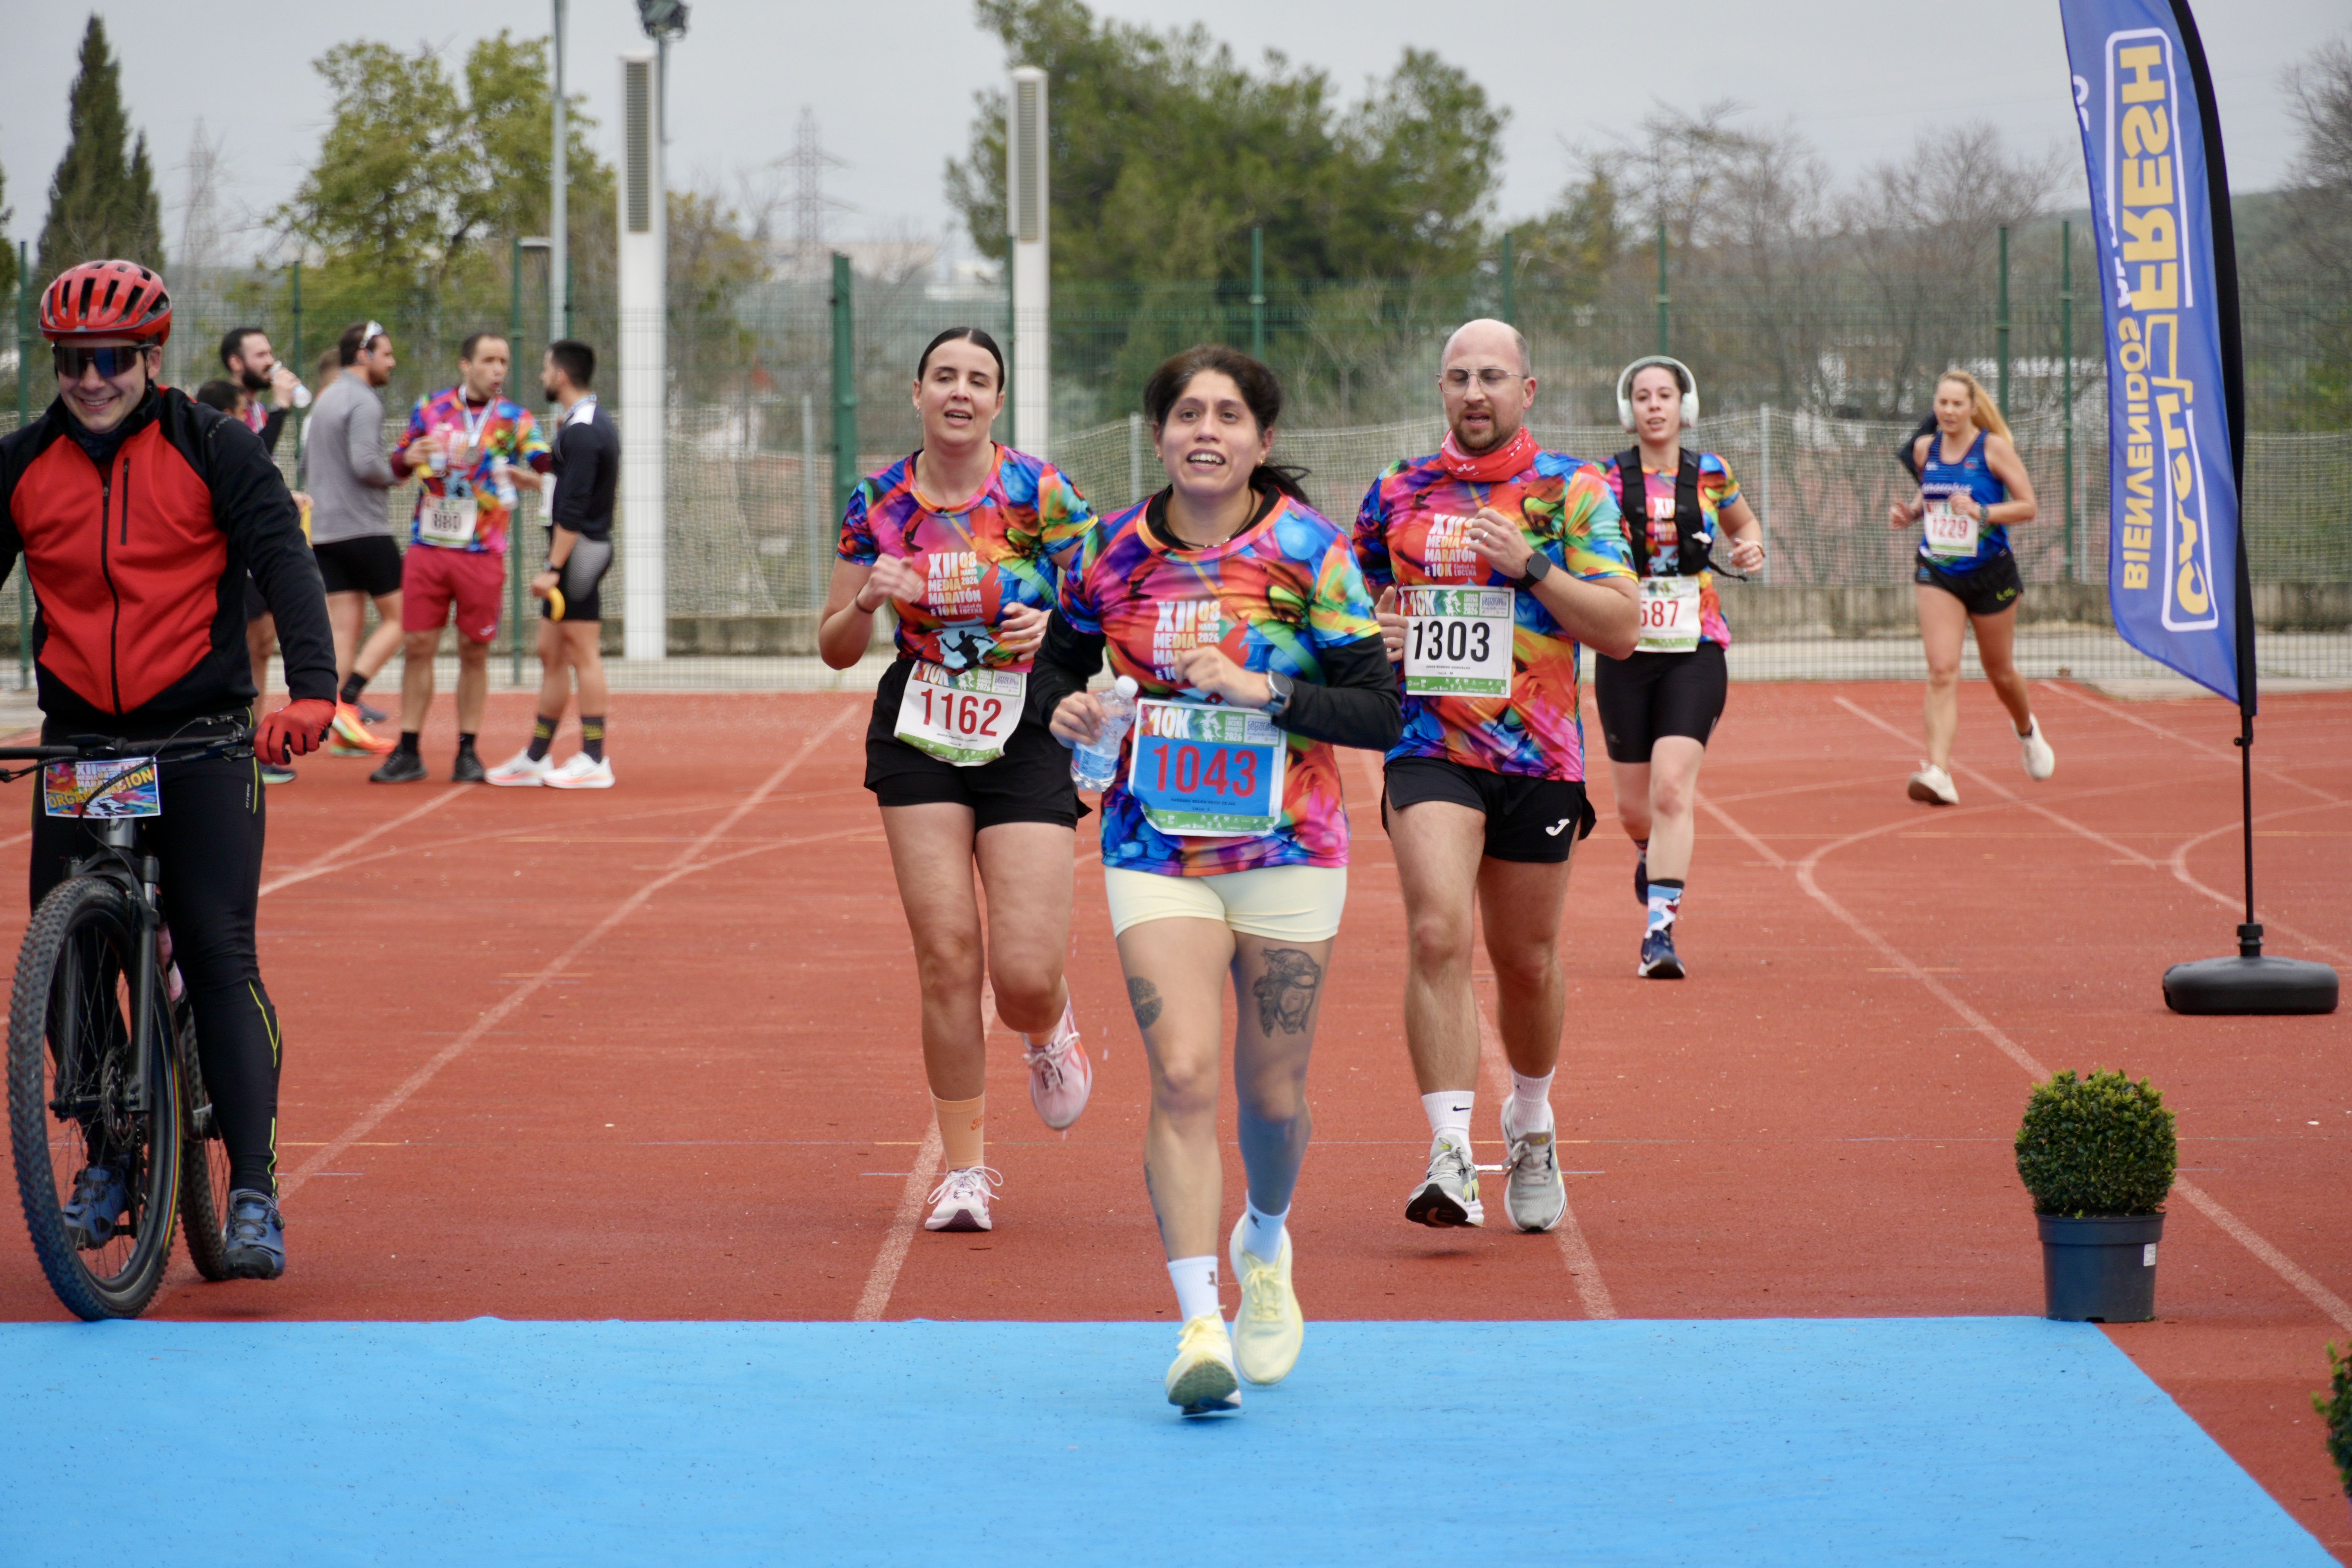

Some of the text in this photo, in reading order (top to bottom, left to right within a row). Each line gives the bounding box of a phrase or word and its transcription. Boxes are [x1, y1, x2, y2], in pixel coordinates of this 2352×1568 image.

[1429, 513, 1467, 536] XII
[1426, 534, 1460, 548] MEDIA
[959, 551, 977, 568] 08
[1425, 546, 1477, 563] MARATÓN
[928, 552, 958, 579] XII
[1424, 563, 1453, 577] & 10K
[928, 577, 962, 592] MEDIA
[961, 576, 979, 586] 2026
[928, 587, 982, 605] MARATÓN
[1410, 590, 1436, 616] 10K
[937, 604, 958, 616] 10K
[1155, 601, 1197, 632] XII
[1198, 601, 1221, 621] 08
[1153, 632, 1197, 649] MEDIA
[1198, 632, 1220, 643] 2026
[1413, 620, 1491, 662] 1303
[920, 688, 1002, 737] 1162
[1149, 707, 1192, 739] 10K
[1225, 732, 1242, 742] 2026
[1153, 743, 1258, 797] 1043
